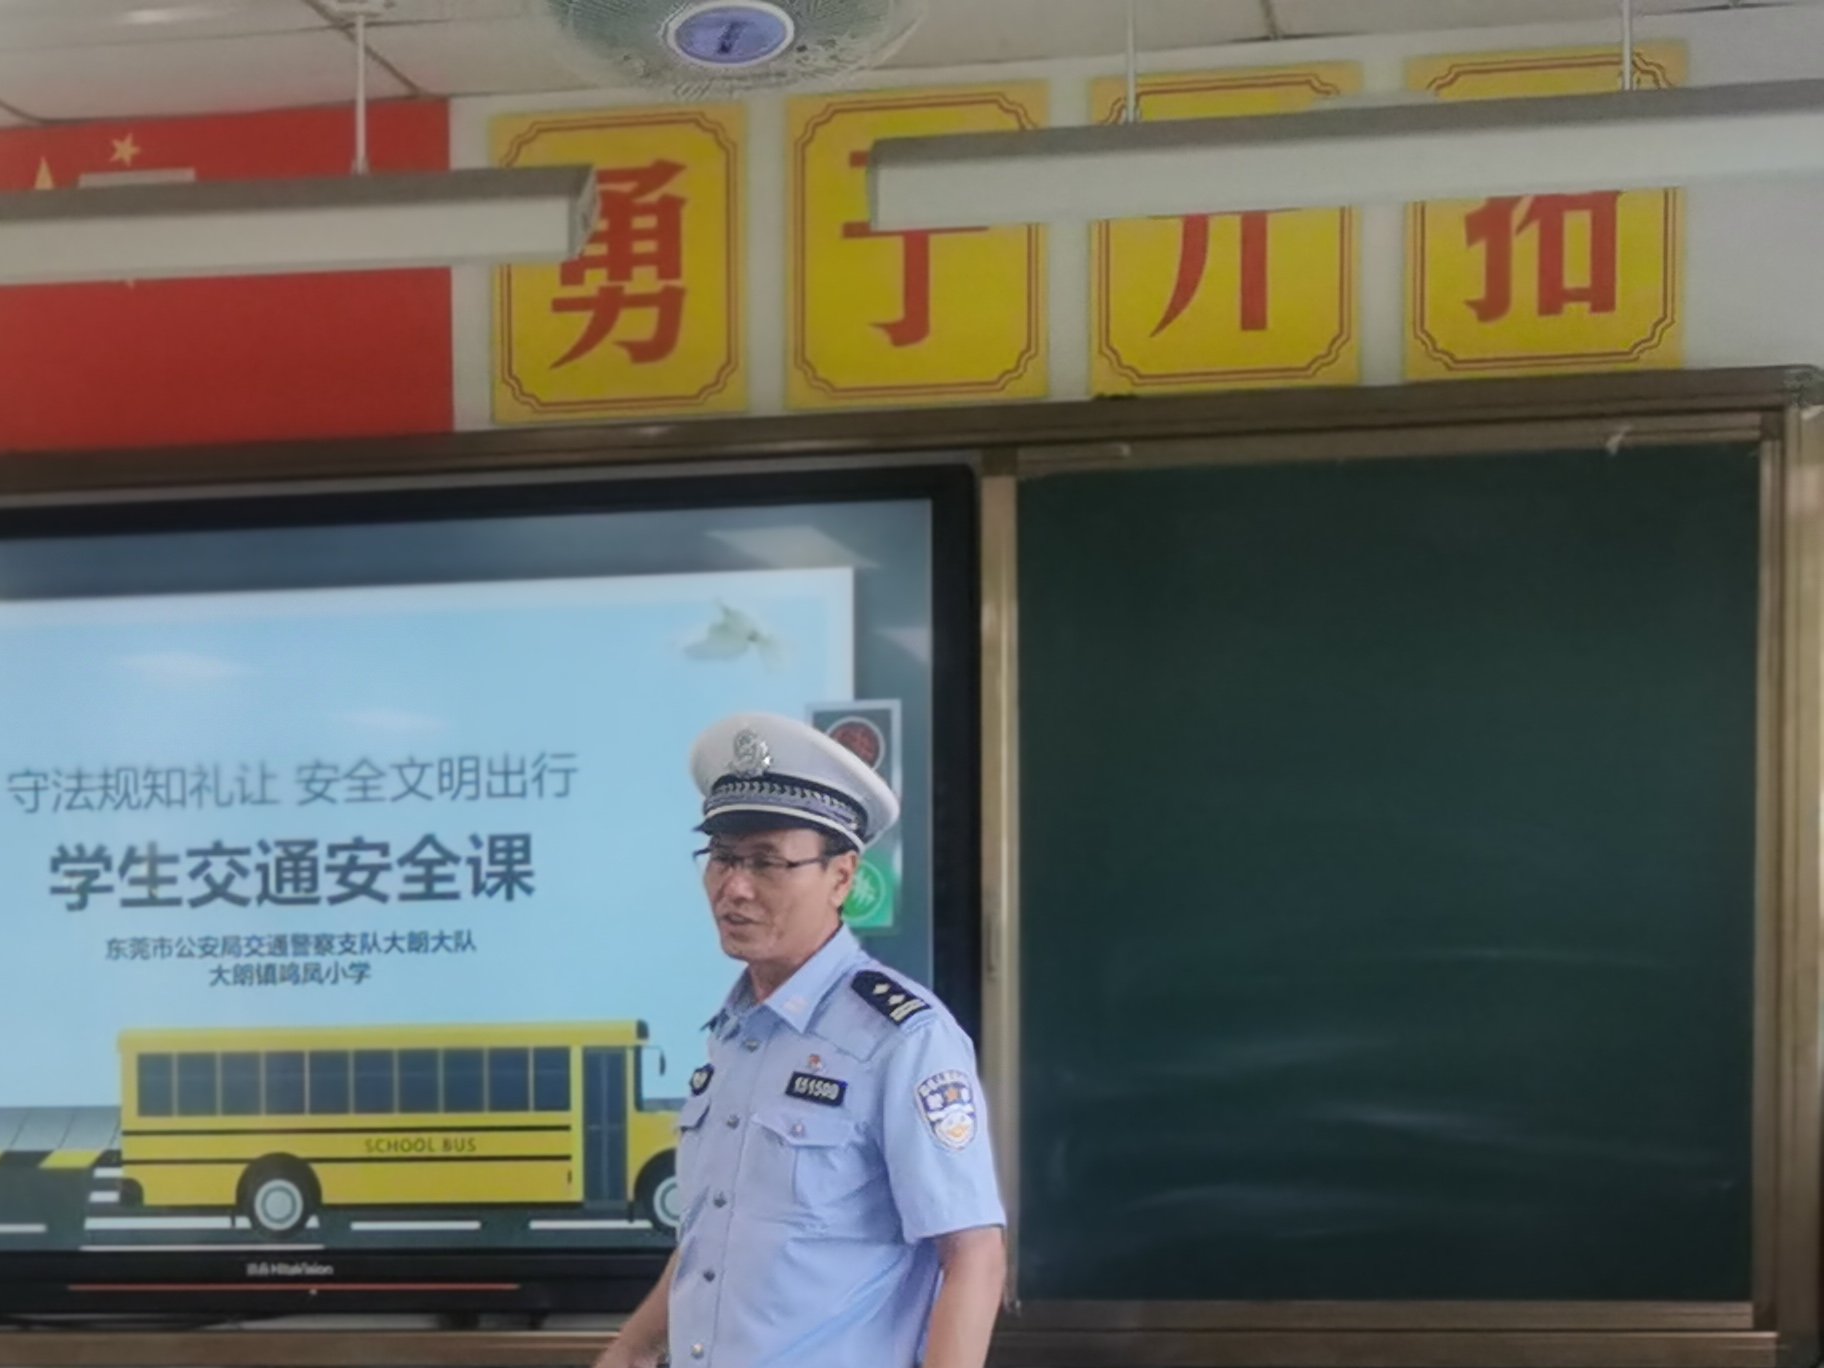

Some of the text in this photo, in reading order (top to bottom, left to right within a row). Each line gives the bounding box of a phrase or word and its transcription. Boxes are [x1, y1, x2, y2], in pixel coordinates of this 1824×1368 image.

[6, 751, 580, 814] 守法规知礼让 安全文明出行
[49, 832, 536, 913] 学生交通安全课
[105, 930, 477, 962] 东莞市公安局交通警察支队大朗大队
[364, 1136, 476, 1153] SCHOOL BUS
